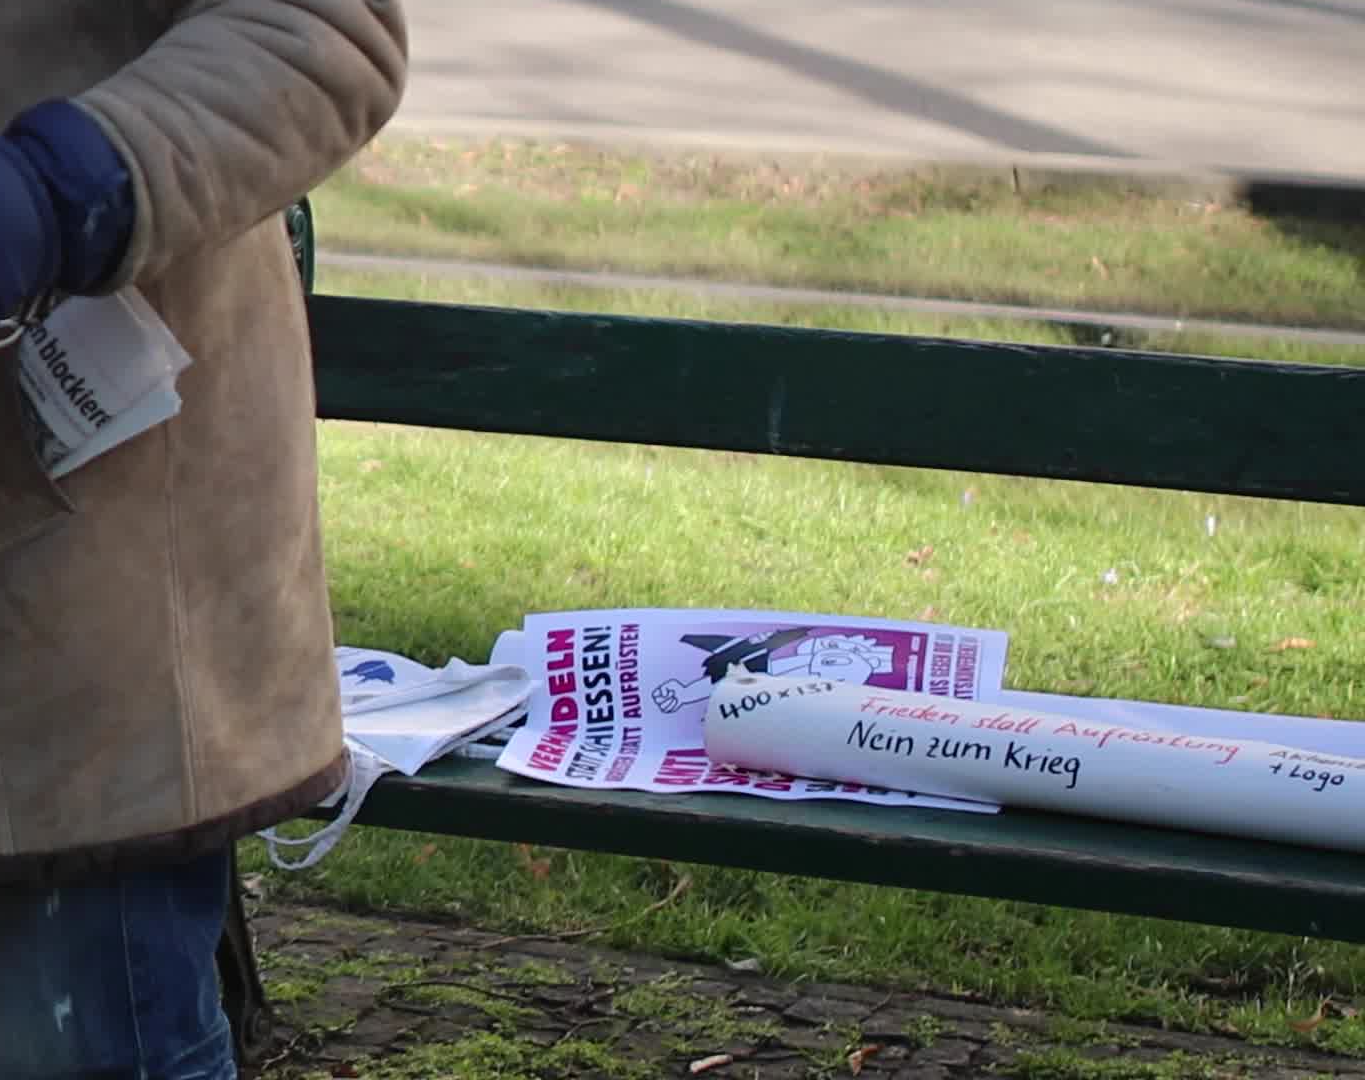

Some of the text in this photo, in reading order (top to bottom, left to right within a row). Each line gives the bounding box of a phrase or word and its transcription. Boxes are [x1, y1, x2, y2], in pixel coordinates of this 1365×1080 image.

[616, 623, 642, 719] AUFRÜSTEN
[719, 690, 771, 720] 400
[860, 695, 959, 724] Frieden
[847, 719, 1082, 790] Nein zum Krieg
[1288, 764, 1345, 793] Logo
